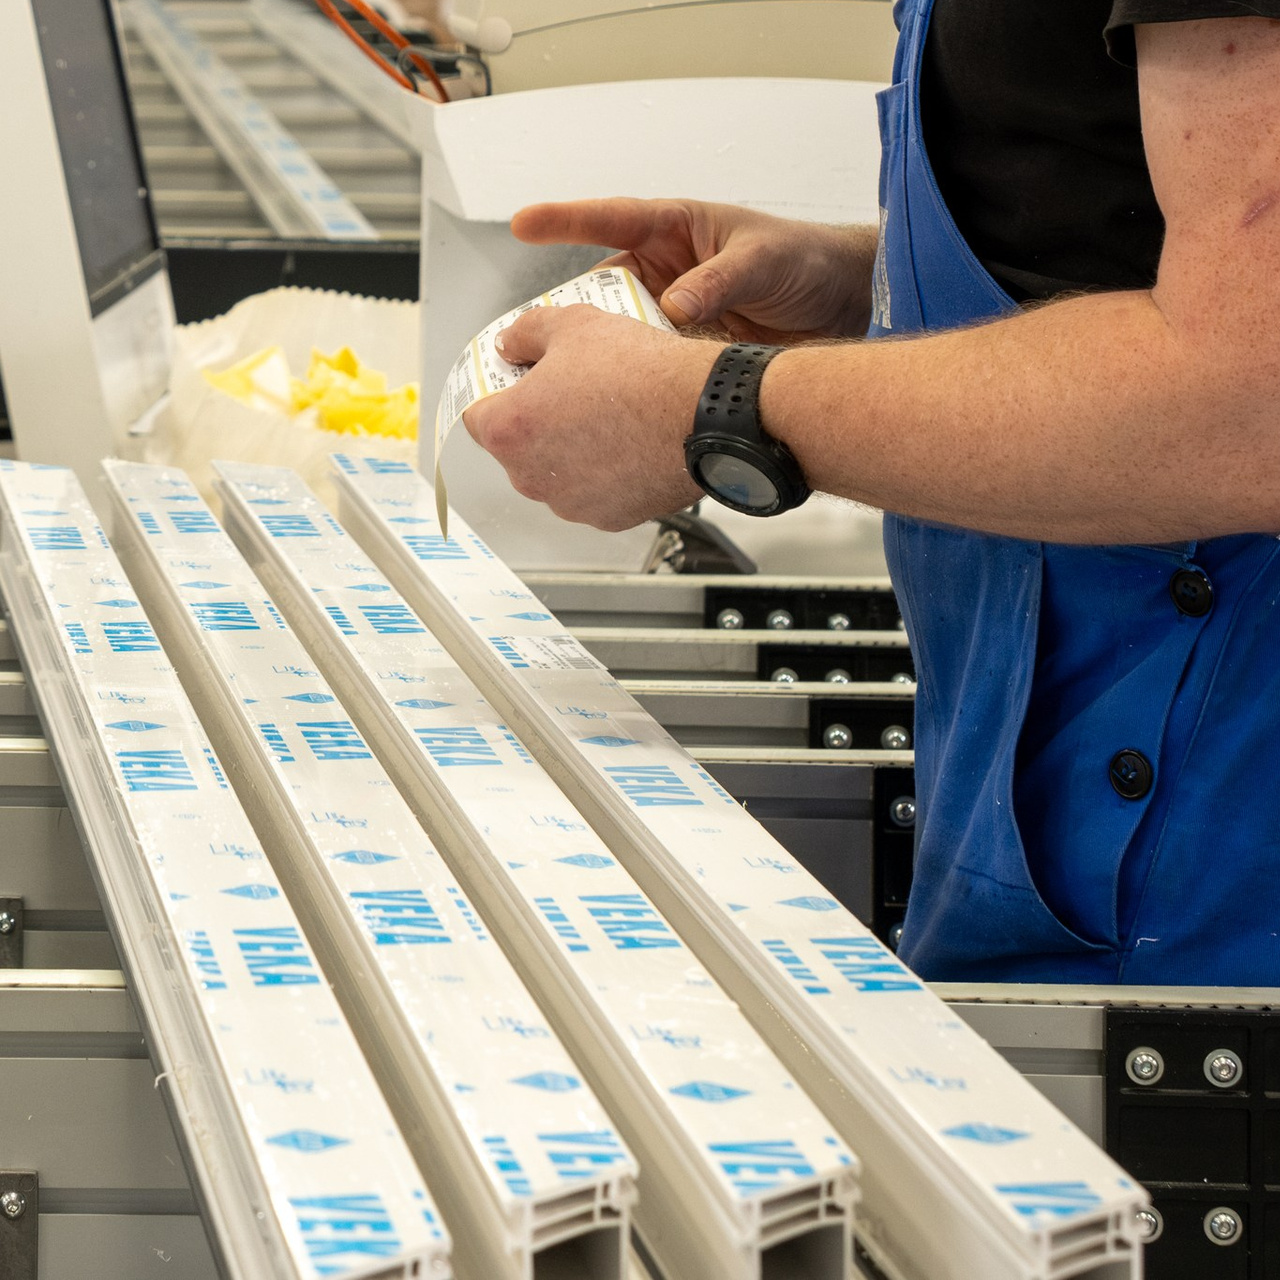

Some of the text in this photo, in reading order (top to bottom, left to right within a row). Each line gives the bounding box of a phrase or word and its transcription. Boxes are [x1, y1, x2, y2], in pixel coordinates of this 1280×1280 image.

[100, 622, 161, 652] VEKA
[189, 602, 260, 631] VEKA
[357, 605, 426, 635] VEKA
[295, 721, 373, 760] VEKA
[413, 726, 504, 767] VEKA
[115, 750, 198, 792] VEKA
[603, 764, 705, 807] VEKA
[349, 889, 453, 945] VEKA
[578, 894, 682, 950] VEKA
[232, 927, 320, 987] VEKA
[809, 936, 924, 993] VEKA
[288, 1195, 403, 1276] VEK
